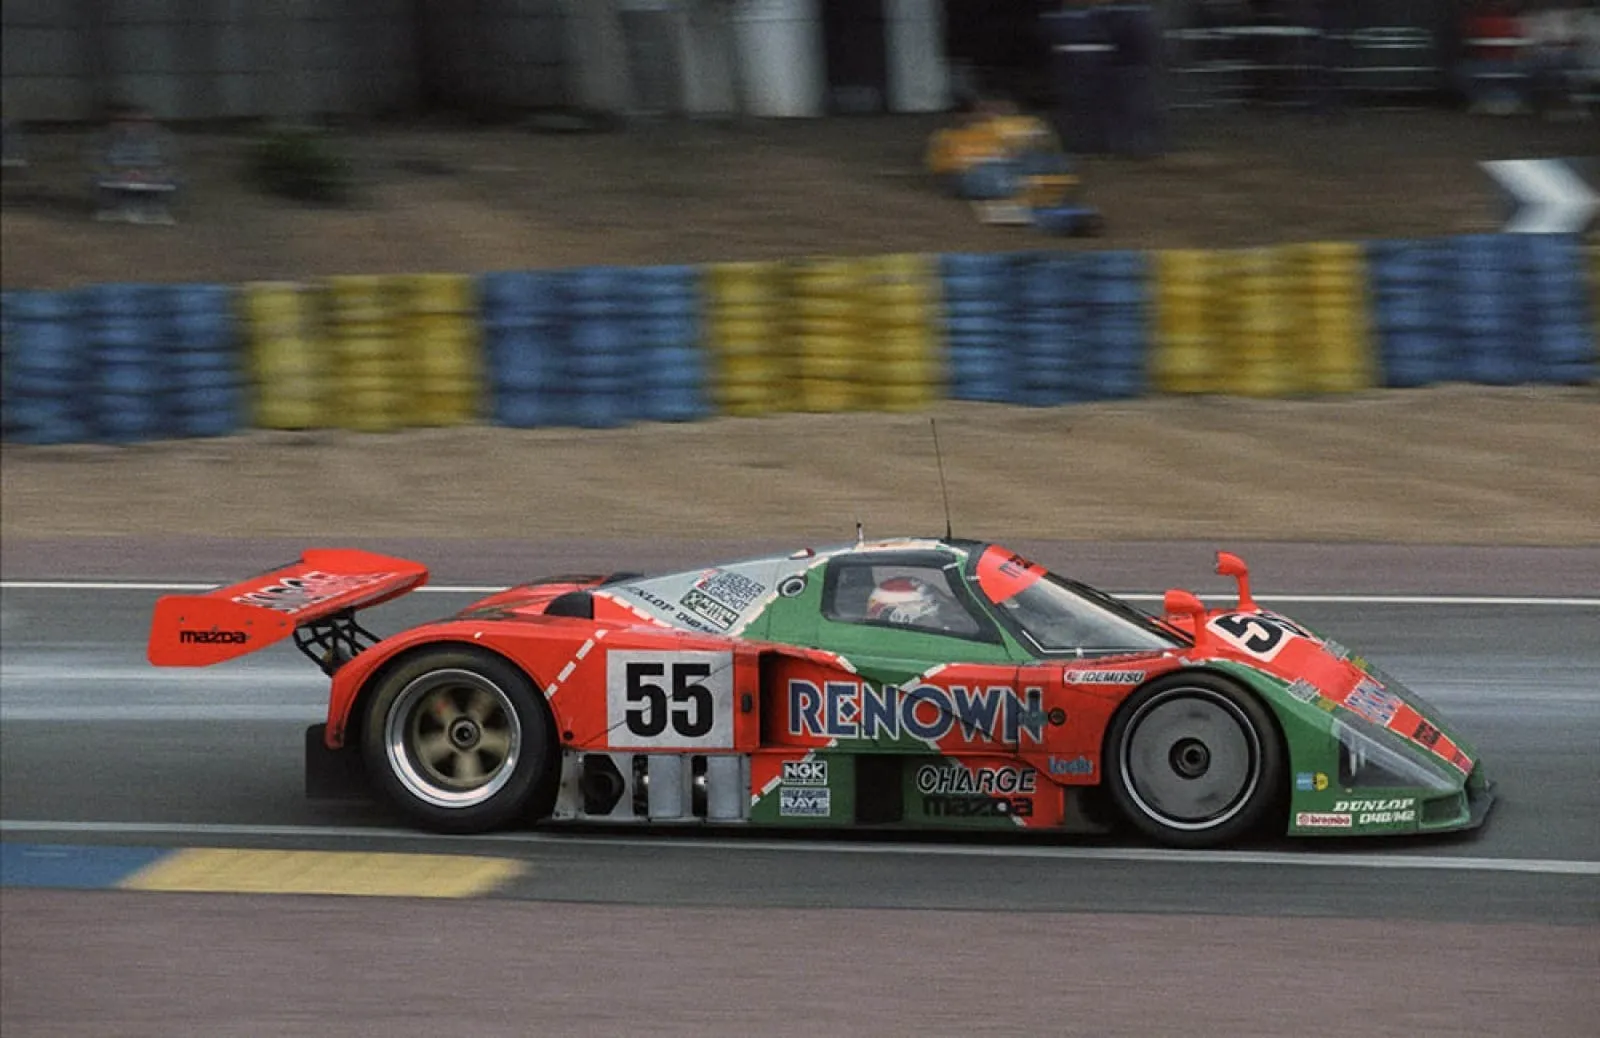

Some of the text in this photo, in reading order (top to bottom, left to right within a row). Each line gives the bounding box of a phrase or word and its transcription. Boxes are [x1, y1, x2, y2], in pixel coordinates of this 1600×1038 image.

[1082, 671, 1145, 682] IDEMITSU
[626, 663, 713, 737] 55
[789, 679, 1043, 743] RENOWN
[784, 763, 824, 779] NGK
[916, 764, 1037, 794] CHARGE
[781, 797, 829, 809] RAYS
[923, 797, 1034, 817] mazda
[1332, 798, 1416, 812] DUNLOP
[1311, 815, 1350, 826] brembo
